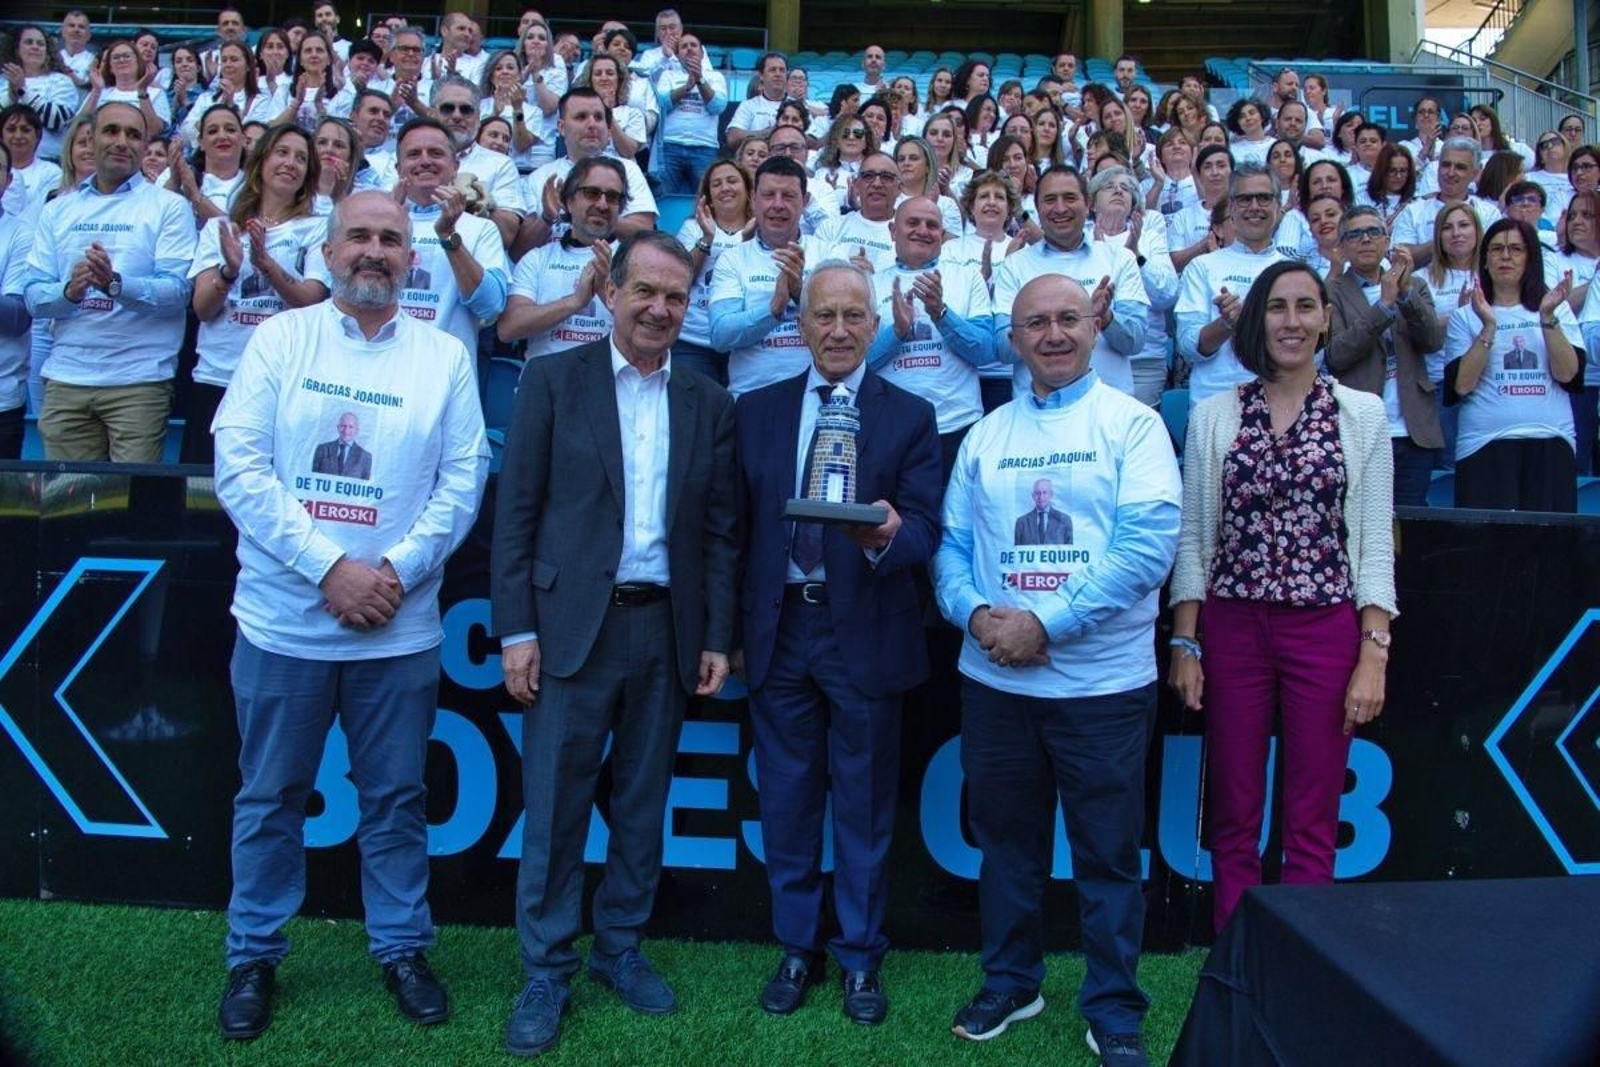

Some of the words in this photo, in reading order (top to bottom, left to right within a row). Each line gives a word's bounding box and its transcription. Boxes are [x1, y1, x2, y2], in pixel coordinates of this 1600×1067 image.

[407, 292, 439, 303] EQUIPO
[575, 318, 606, 328] EQUIPO
[912, 342, 943, 351] EQUIPO
[302, 377, 351, 398] ¡GRACIAS
[353, 389, 404, 408] JOAQUÍN!
[998, 457, 1045, 470] ¡GRACIAS
[1047, 450, 1097, 465] JOAQUÍN!
[296, 476, 312, 490] DE
[315, 478, 331, 492] TU
[335, 481, 384, 500] EQUIPO
[318, 504, 375, 522] EROSKI
[1000, 551, 1015, 564] DE
[1018, 550, 1035, 563] TU
[1040, 550, 1090, 564] EQUIPO
